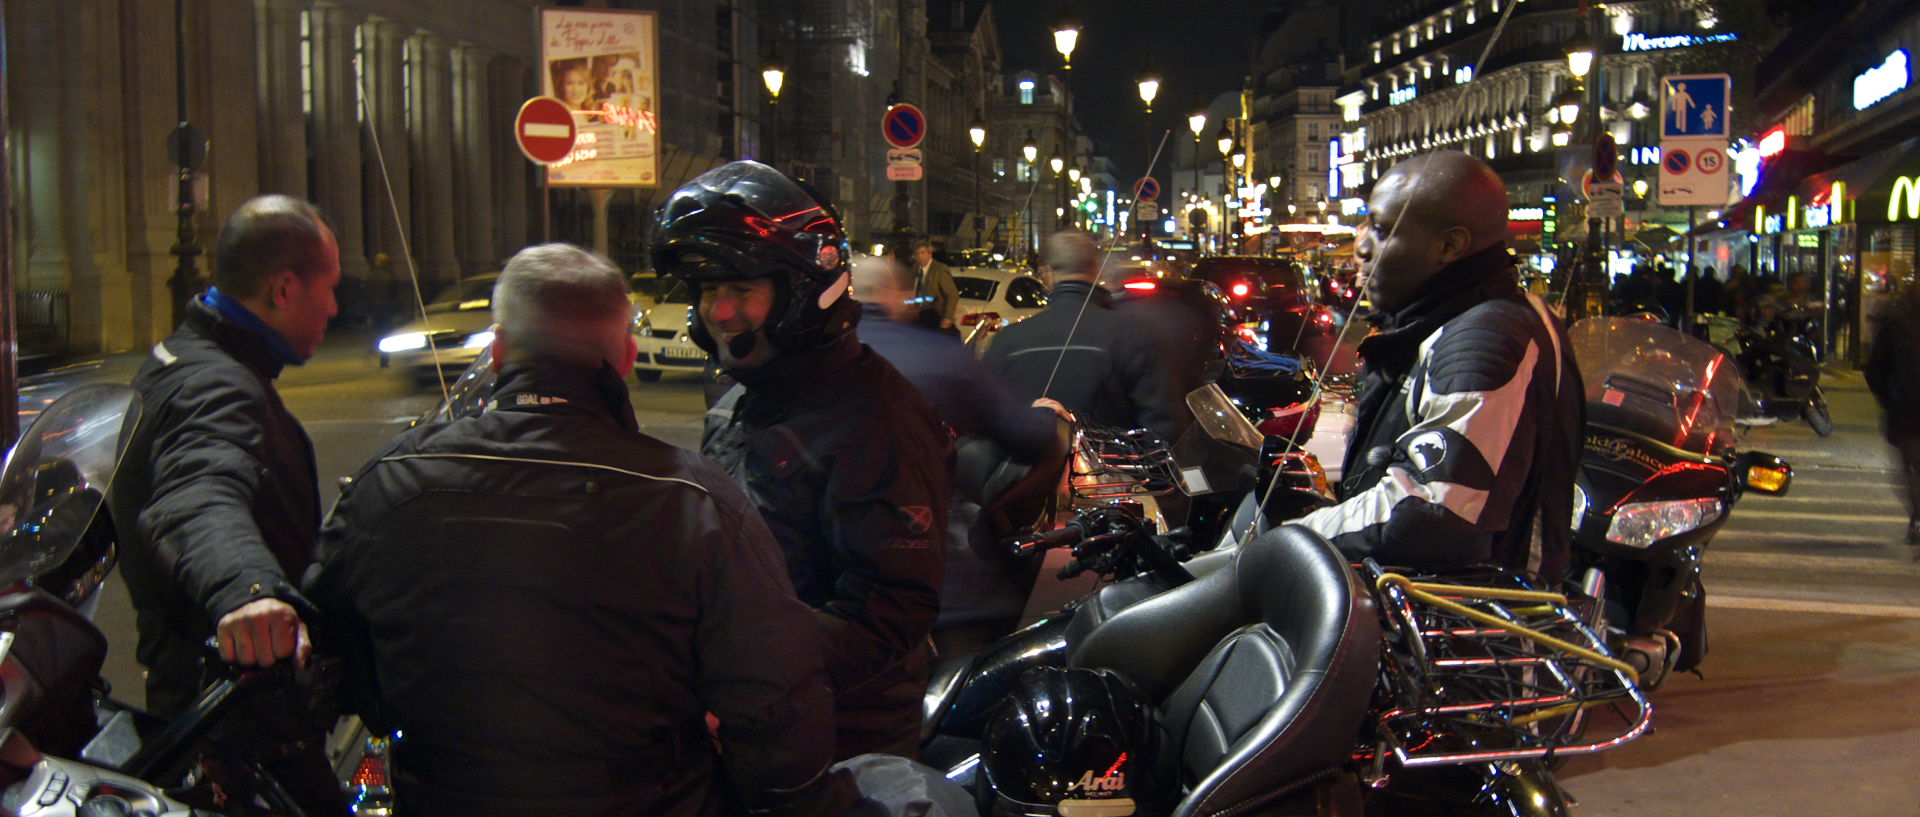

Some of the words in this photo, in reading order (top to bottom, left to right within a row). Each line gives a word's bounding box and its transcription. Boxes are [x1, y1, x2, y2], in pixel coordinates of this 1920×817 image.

[1622, 33, 1692, 51] Mercure
[1703, 156, 1716, 168] 15
[1067, 770, 1126, 791] Arai
